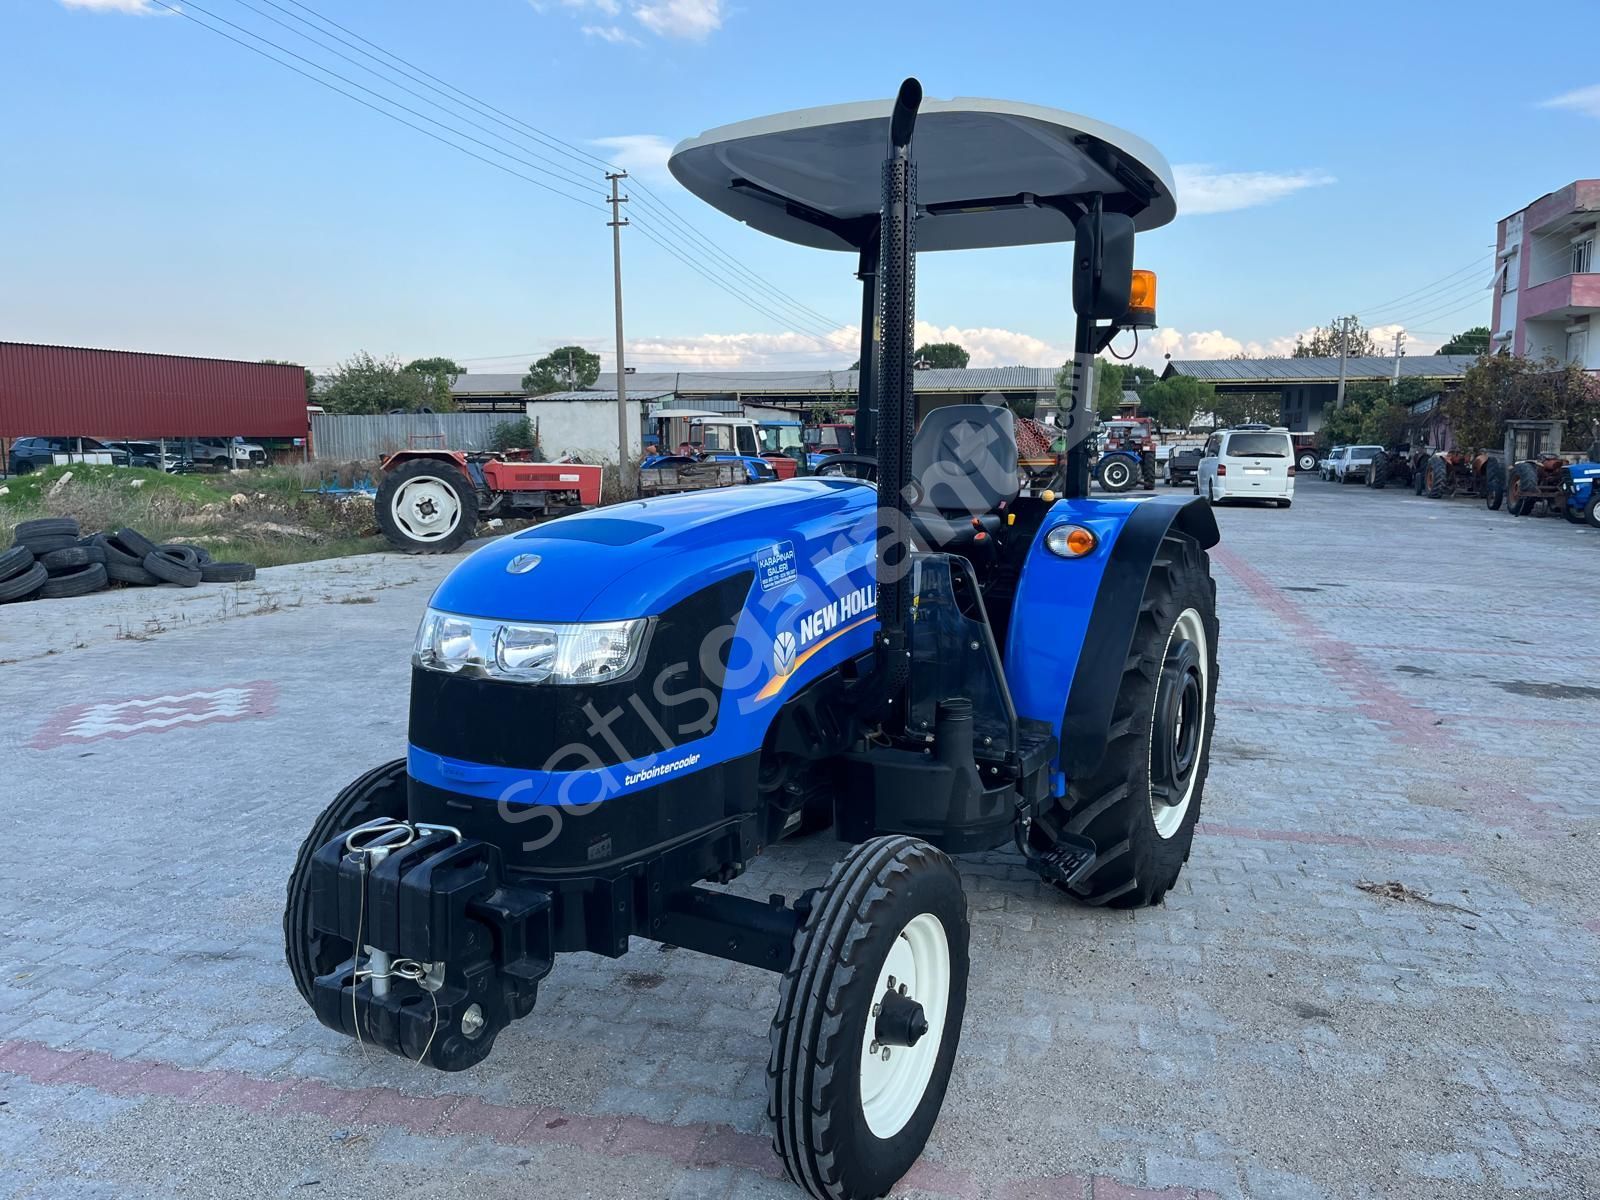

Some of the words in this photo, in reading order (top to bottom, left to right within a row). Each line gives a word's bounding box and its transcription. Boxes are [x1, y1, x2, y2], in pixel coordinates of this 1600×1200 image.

[800, 601, 838, 645] NEW
[840, 584, 877, 622] HOLL
[624, 753, 701, 786] turbointercooler
